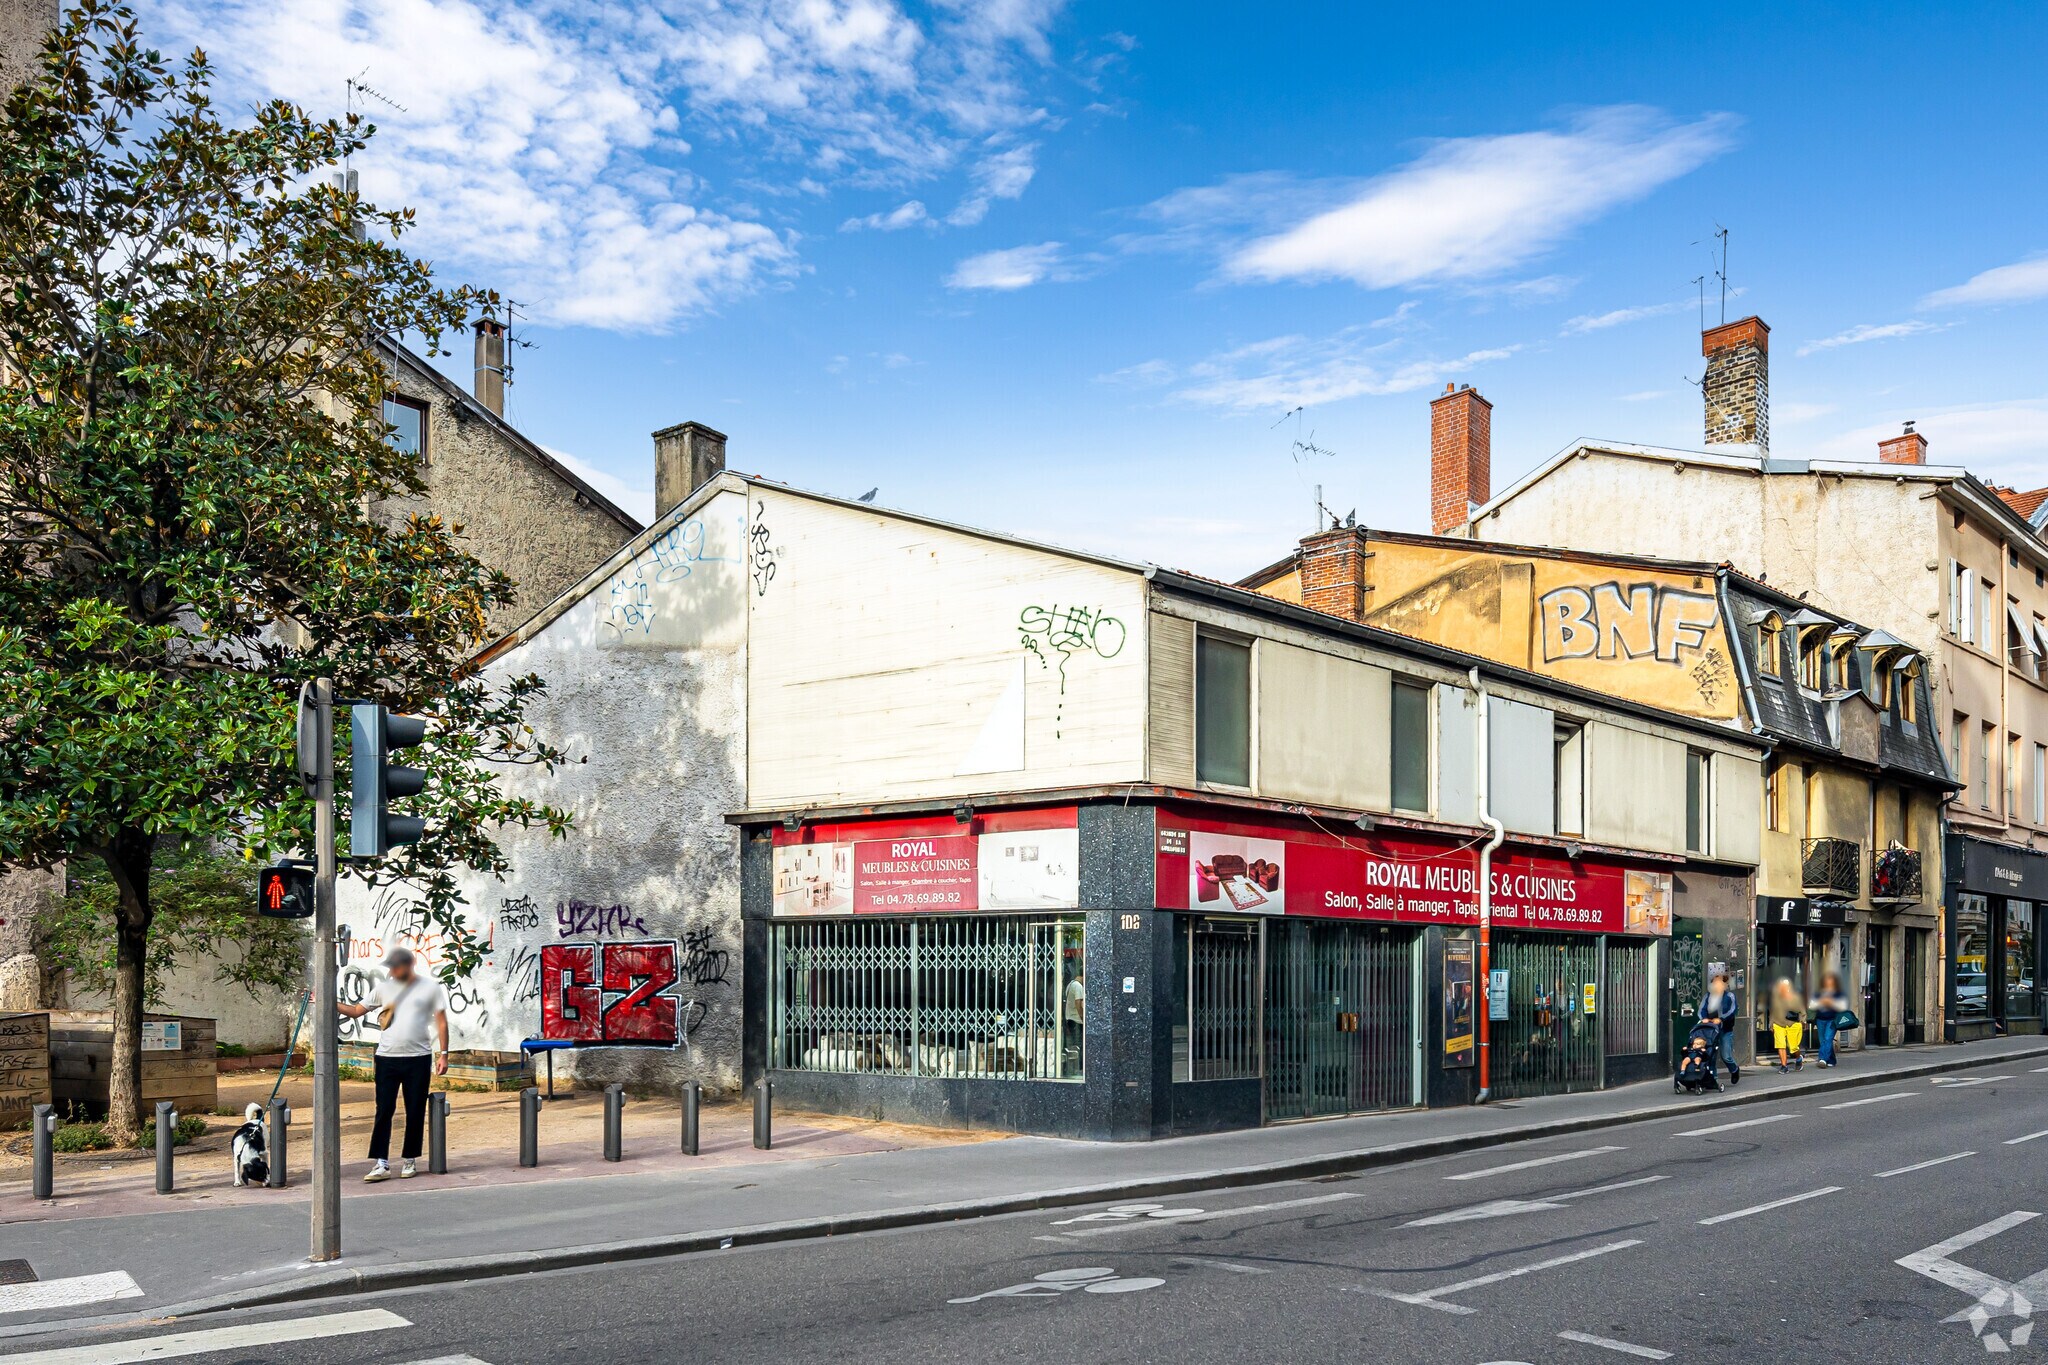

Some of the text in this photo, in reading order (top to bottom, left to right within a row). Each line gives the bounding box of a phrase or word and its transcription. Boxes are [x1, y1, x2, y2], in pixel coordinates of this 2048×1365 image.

[1538, 581, 1719, 665] BNF
[891, 841, 937, 858] ROYAL
[862, 858, 970, 874] MEUBLES & CUISINES
[1366, 861, 1576, 902] ROYAL MEUBLS & CUISINES
[871, 892, 961, 905] Tel 04.78.69.89.82
[1324, 890, 1603, 923] Salon, Salle à manger, Tapis riental Tel 04.78.69.89.82
[1780, 900, 1796, 922] f
